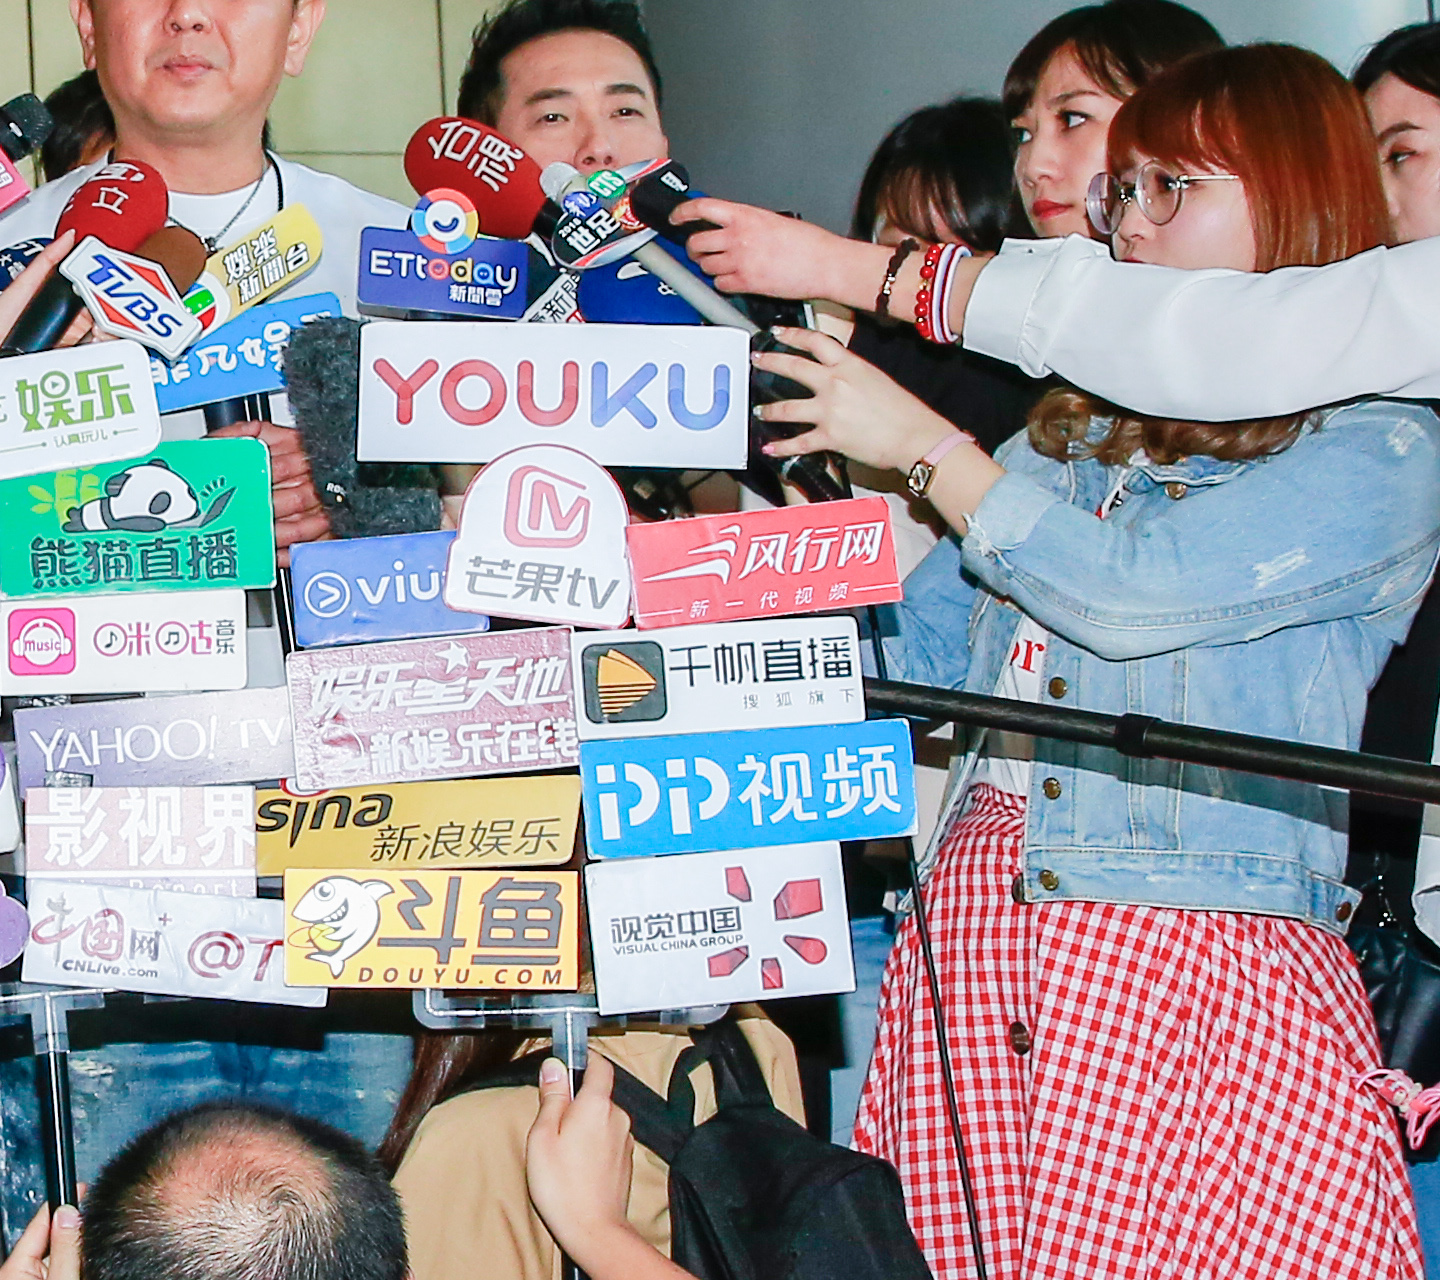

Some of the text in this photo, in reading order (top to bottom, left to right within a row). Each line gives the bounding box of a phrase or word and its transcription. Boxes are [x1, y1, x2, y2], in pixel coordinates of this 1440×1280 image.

[589, 170, 624, 197] CTS
[87, 252, 185, 340] TVBS
[370, 249, 518, 295] ETtoday
[449, 283, 503, 307] 新聞雲
[15, 364, 136, 432] 娱乐
[373, 358, 731, 431] YOUKU
[31, 528, 239, 589] 熊猫直播
[737, 520, 886, 581] 风行网
[466, 554, 622, 610] 芒果tv
[24, 638, 61, 652] music
[669, 636, 853, 687] 千帆直播
[30, 715, 287, 771] YAHOO! TV
[26, 786, 256, 868] 影视界
[372, 816, 561, 863] 新浪娱乐
[378, 874, 563, 965] 斗鱼
[610, 905, 742, 944] 视觉中国
[612, 933, 744, 956] VISUAL CHINA GROUP
[358, 967, 564, 988] DOUYU.COM
